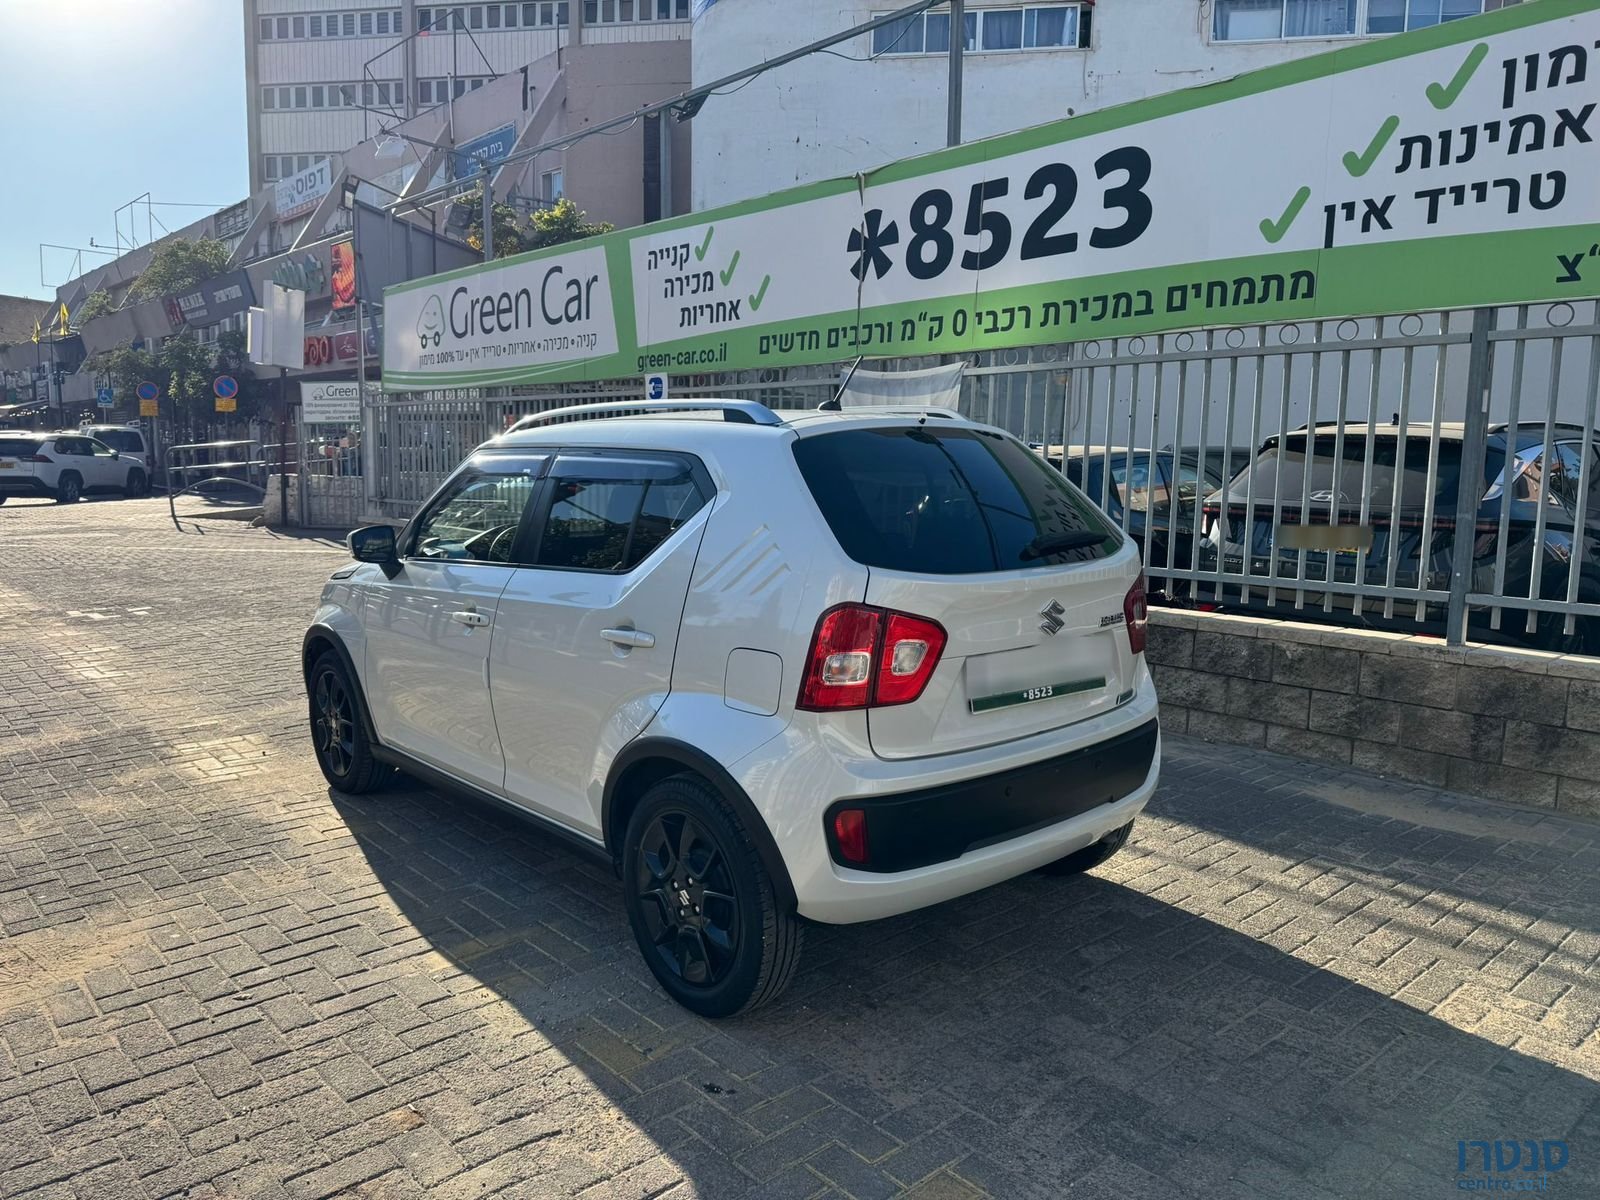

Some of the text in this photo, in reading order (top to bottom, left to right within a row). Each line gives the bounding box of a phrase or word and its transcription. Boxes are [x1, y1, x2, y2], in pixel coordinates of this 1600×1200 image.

[1395, 103, 1598, 174] אמינות
[296, 167, 325, 195] דפוס
[1324, 170, 1567, 249] טרייד אין
[648, 243, 690, 271] קנייה
[664, 270, 714, 298] מכירה
[1166, 270, 1315, 312] מתמחים
[450, 265, 598, 339] Green Car
[679, 299, 741, 327] אחריות
[1039, 289, 1154, 328] במכירת
[952, 308, 968, 337] 0
[975, 305, 1031, 334] רכבי
[507, 341, 536, 356] אחריות
[543, 336, 569, 352] מכירה
[576, 333, 597, 351] קניה
[759, 330, 820, 355] חדשים
[827, 321, 893, 349] ורכבים
[436, 351, 455, 364] 100%
[469, 347, 480, 363] אין
[481, 345, 501, 358] טרייד
[637, 342, 727, 372] green-car.co.il
[326, 385, 358, 397] Green
